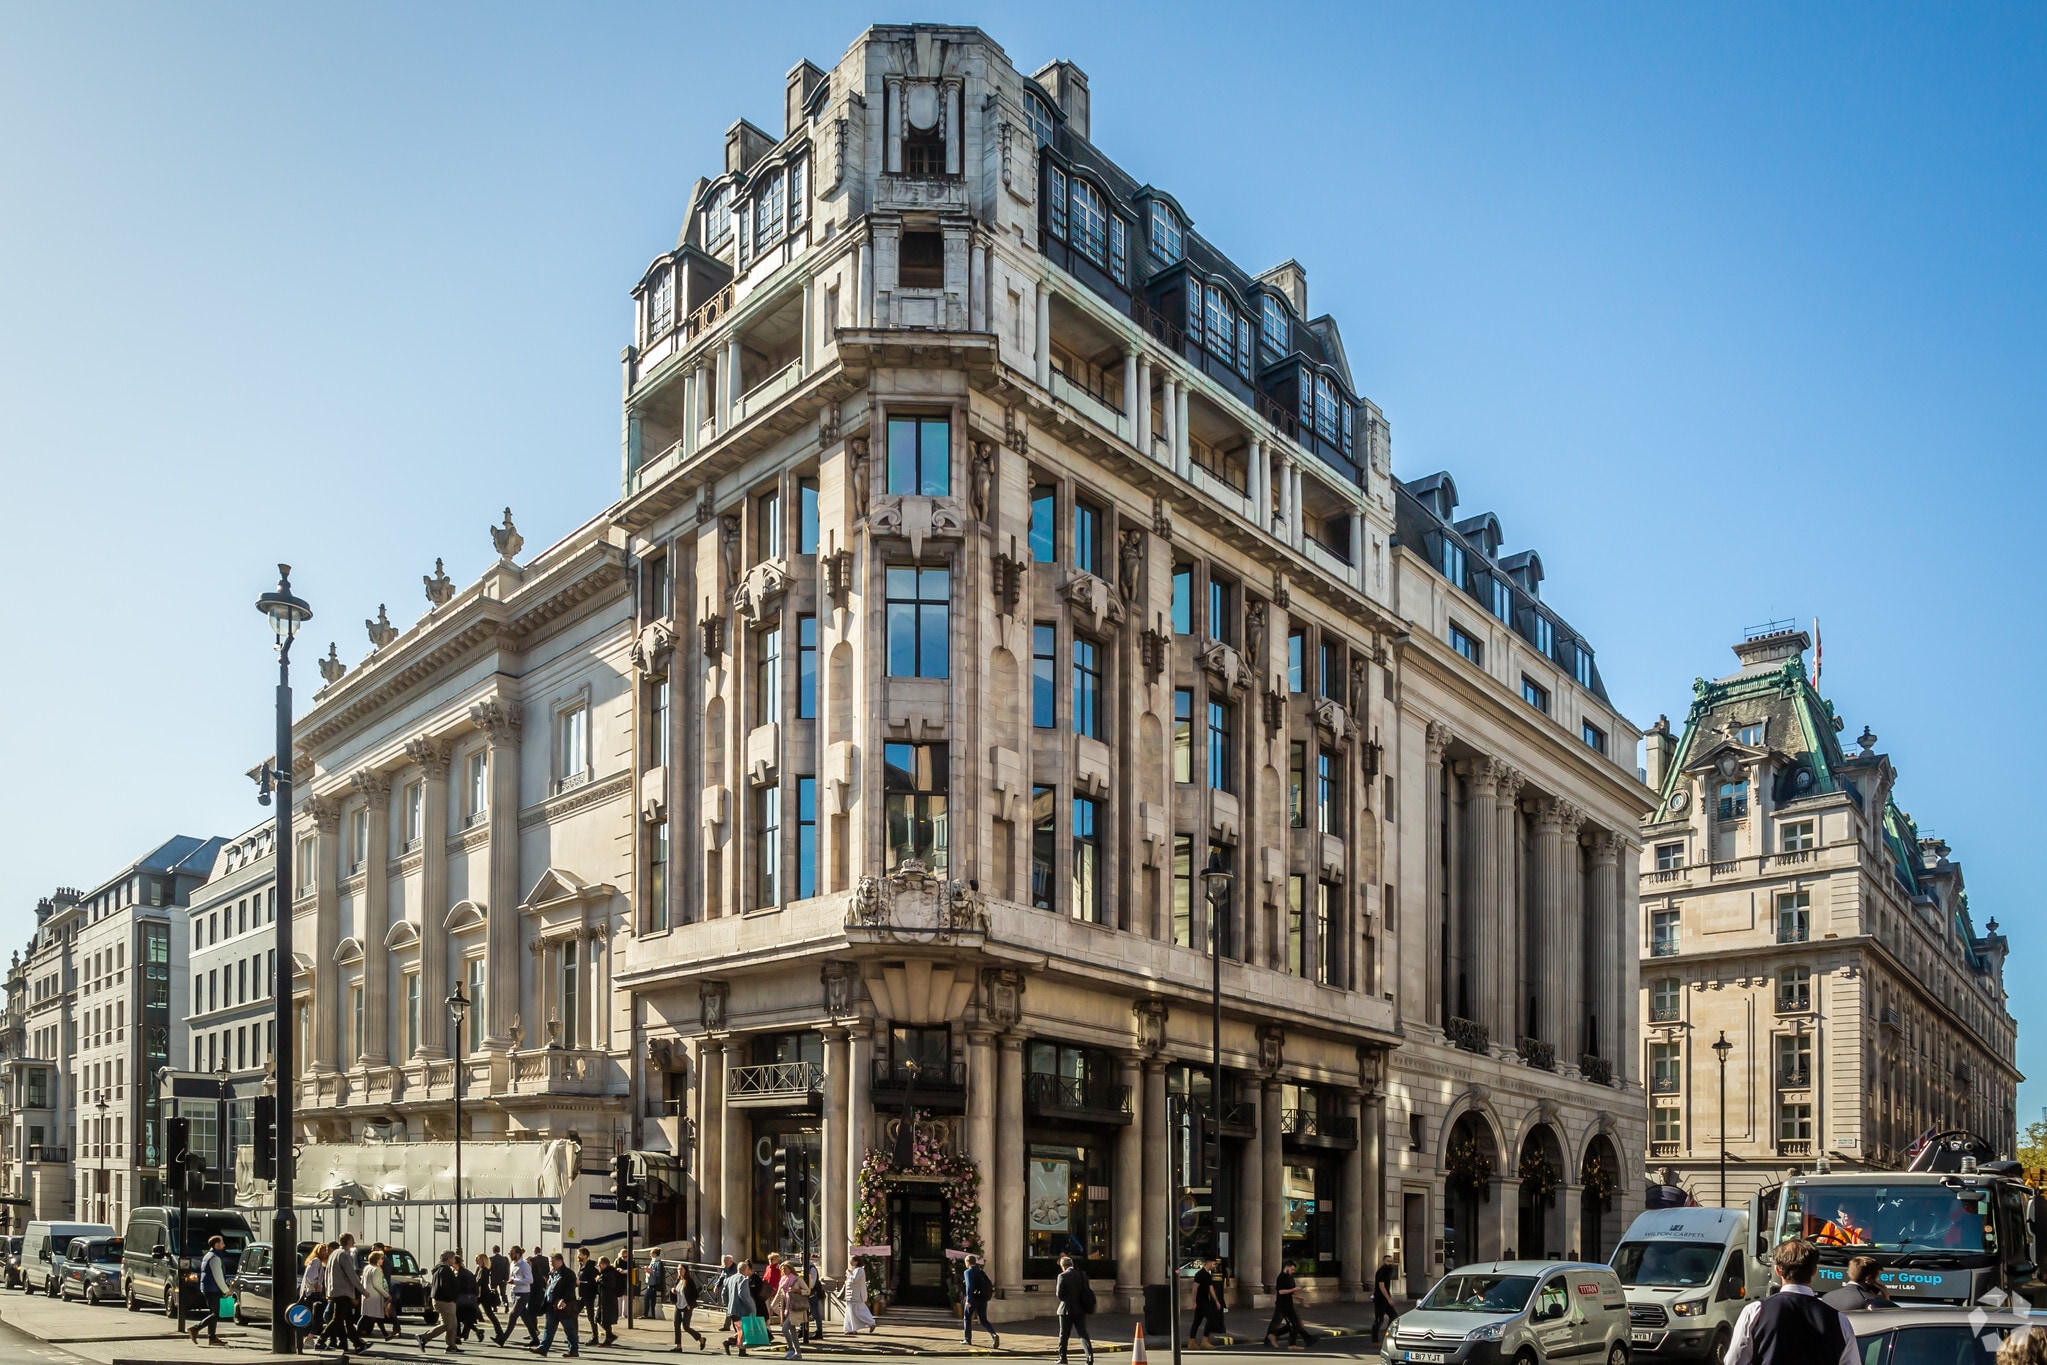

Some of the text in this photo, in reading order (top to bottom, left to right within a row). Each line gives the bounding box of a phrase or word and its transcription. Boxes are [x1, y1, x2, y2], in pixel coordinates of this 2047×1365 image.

[1818, 1269, 1843, 1280] The
[1898, 1273, 1943, 1286] Group
[1579, 1285, 1598, 1294] TITAN
[1427, 1353, 1441, 1362] YJT
